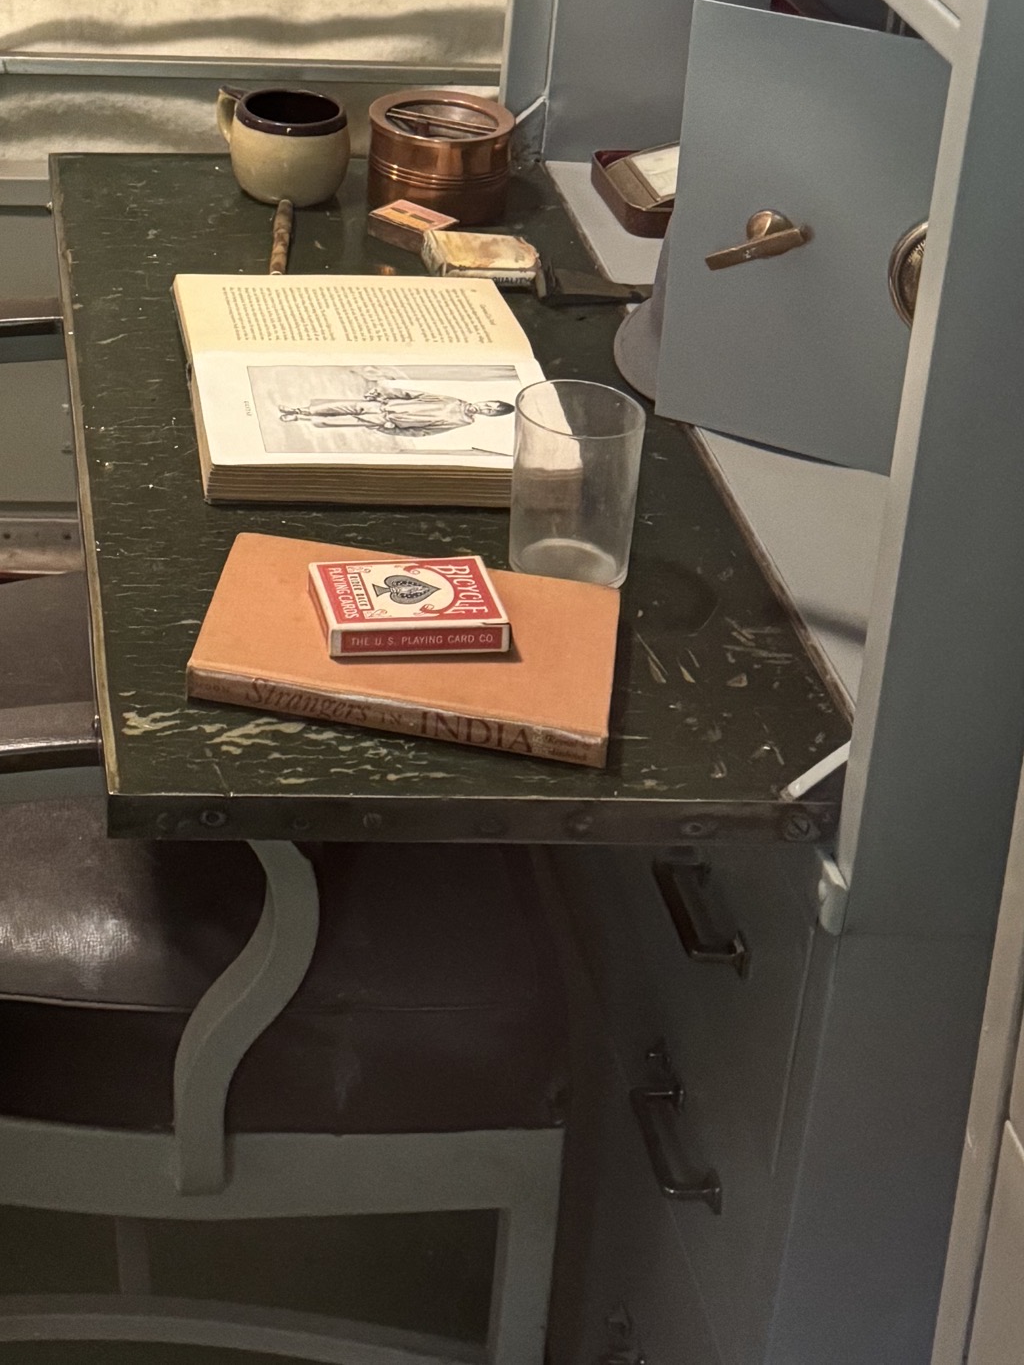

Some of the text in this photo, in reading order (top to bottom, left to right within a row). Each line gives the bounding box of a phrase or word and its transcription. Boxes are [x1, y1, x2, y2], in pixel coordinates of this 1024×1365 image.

[328, 567, 360, 619] PLAYING CARDS
[430, 564, 489, 615] BICYCLE
[351, 637, 370, 646] THE
[401, 635, 443, 645] PLAYING
[448, 634, 475, 644] CARD
[246, 677, 372, 722] Strangers
[420, 710, 533, 754] INDIA
